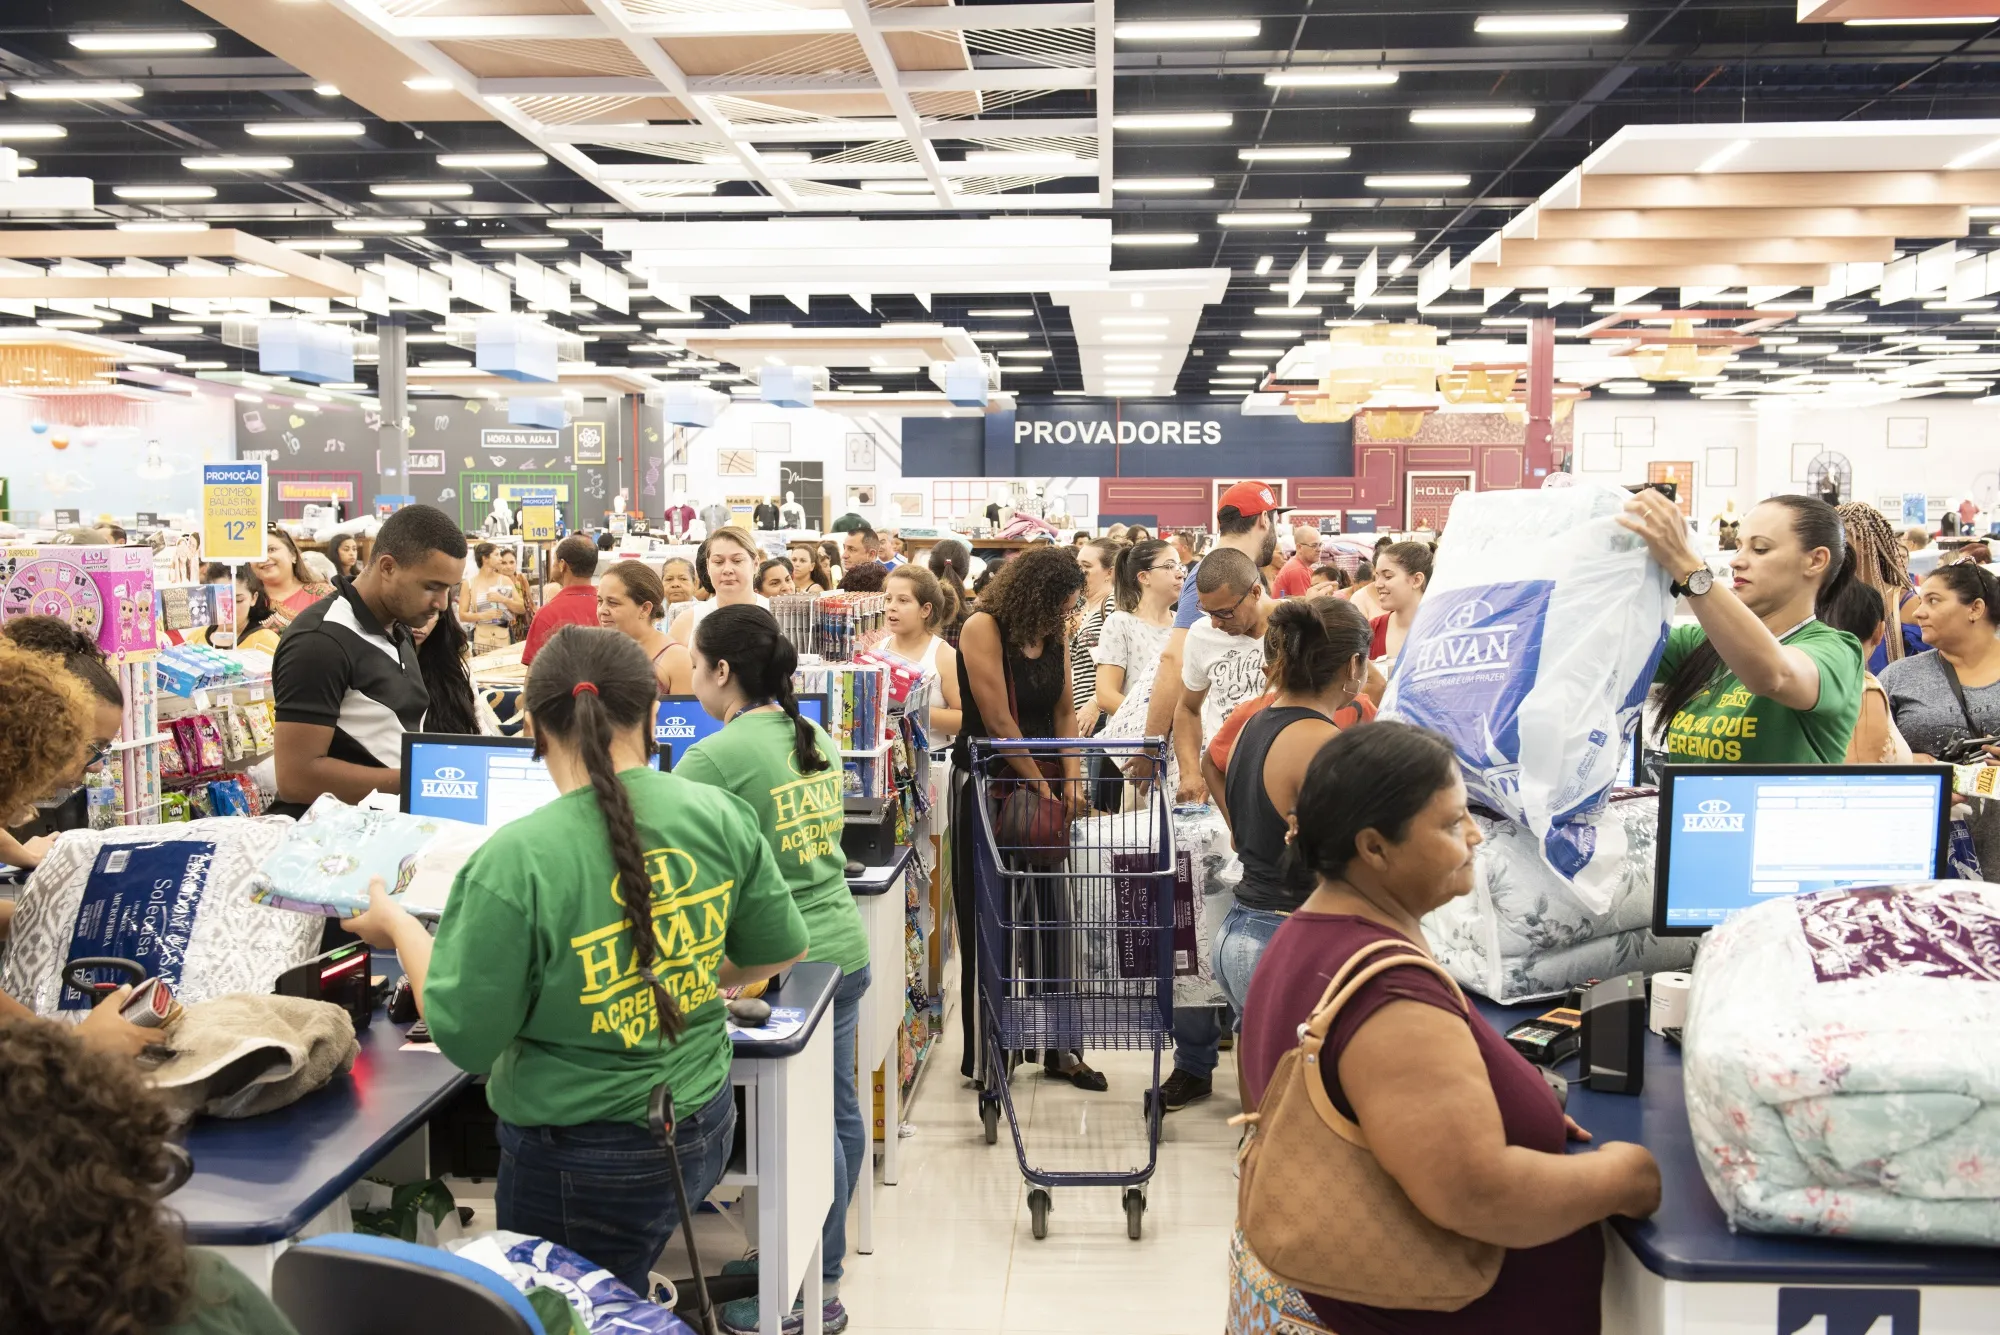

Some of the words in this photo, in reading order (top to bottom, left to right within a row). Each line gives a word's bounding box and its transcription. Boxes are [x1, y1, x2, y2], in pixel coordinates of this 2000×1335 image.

[487, 433, 512, 444] HORA
[514, 433, 527, 444] DA
[529, 433, 553, 444] AULA
[1013, 421, 1222, 444] PROVADORES
[206, 470, 260, 482] PROMOÇÃO
[213, 487, 253, 497] COMBO
[1415, 487, 1461, 496] HOLLA
[209, 498, 240, 507] BALAS
[241, 498, 256, 507] FINI
[208, 508, 214, 516] 3
[215, 508, 257, 516] UNIDADES
[1414, 631, 1515, 674] HAVAN
[1475, 672, 1506, 683] PRAZER
[656, 726, 696, 737] HAVAN
[1712, 715, 1758, 738] QUE
[1668, 732, 1742, 762] EREMOS
[421, 780, 479, 798] HAVAN
[1683, 815, 1744, 831] HAVAN
[1178, 858, 1188, 882] HAVAN
[102, 892, 125, 948] MICROFIBRA
[618, 1016, 646, 1049] NO
